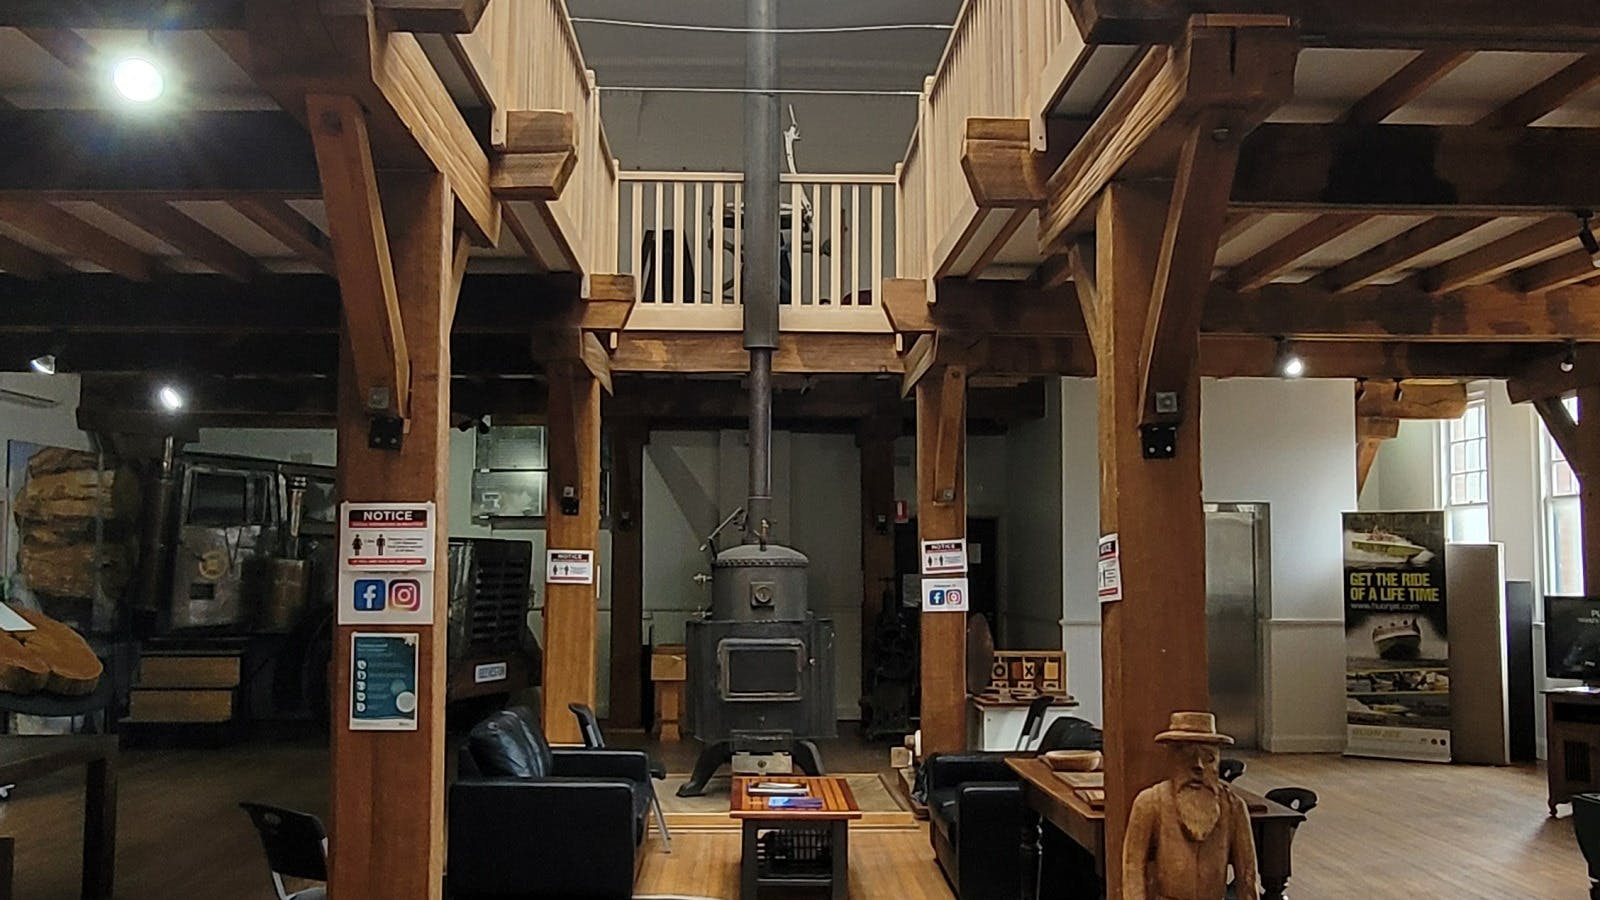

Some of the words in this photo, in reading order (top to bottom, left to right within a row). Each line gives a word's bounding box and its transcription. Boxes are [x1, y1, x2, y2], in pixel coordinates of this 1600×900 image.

[363, 511, 413, 521] NOTICE
[1350, 573, 1373, 586] GET
[1375, 573, 1399, 586] THE
[1402, 573, 1431, 586] RIDE
[1350, 588, 1366, 601] OF
[1368, 588, 1378, 601] A
[1380, 588, 1405, 601] LIFE
[1408, 588, 1440, 602] TIME
